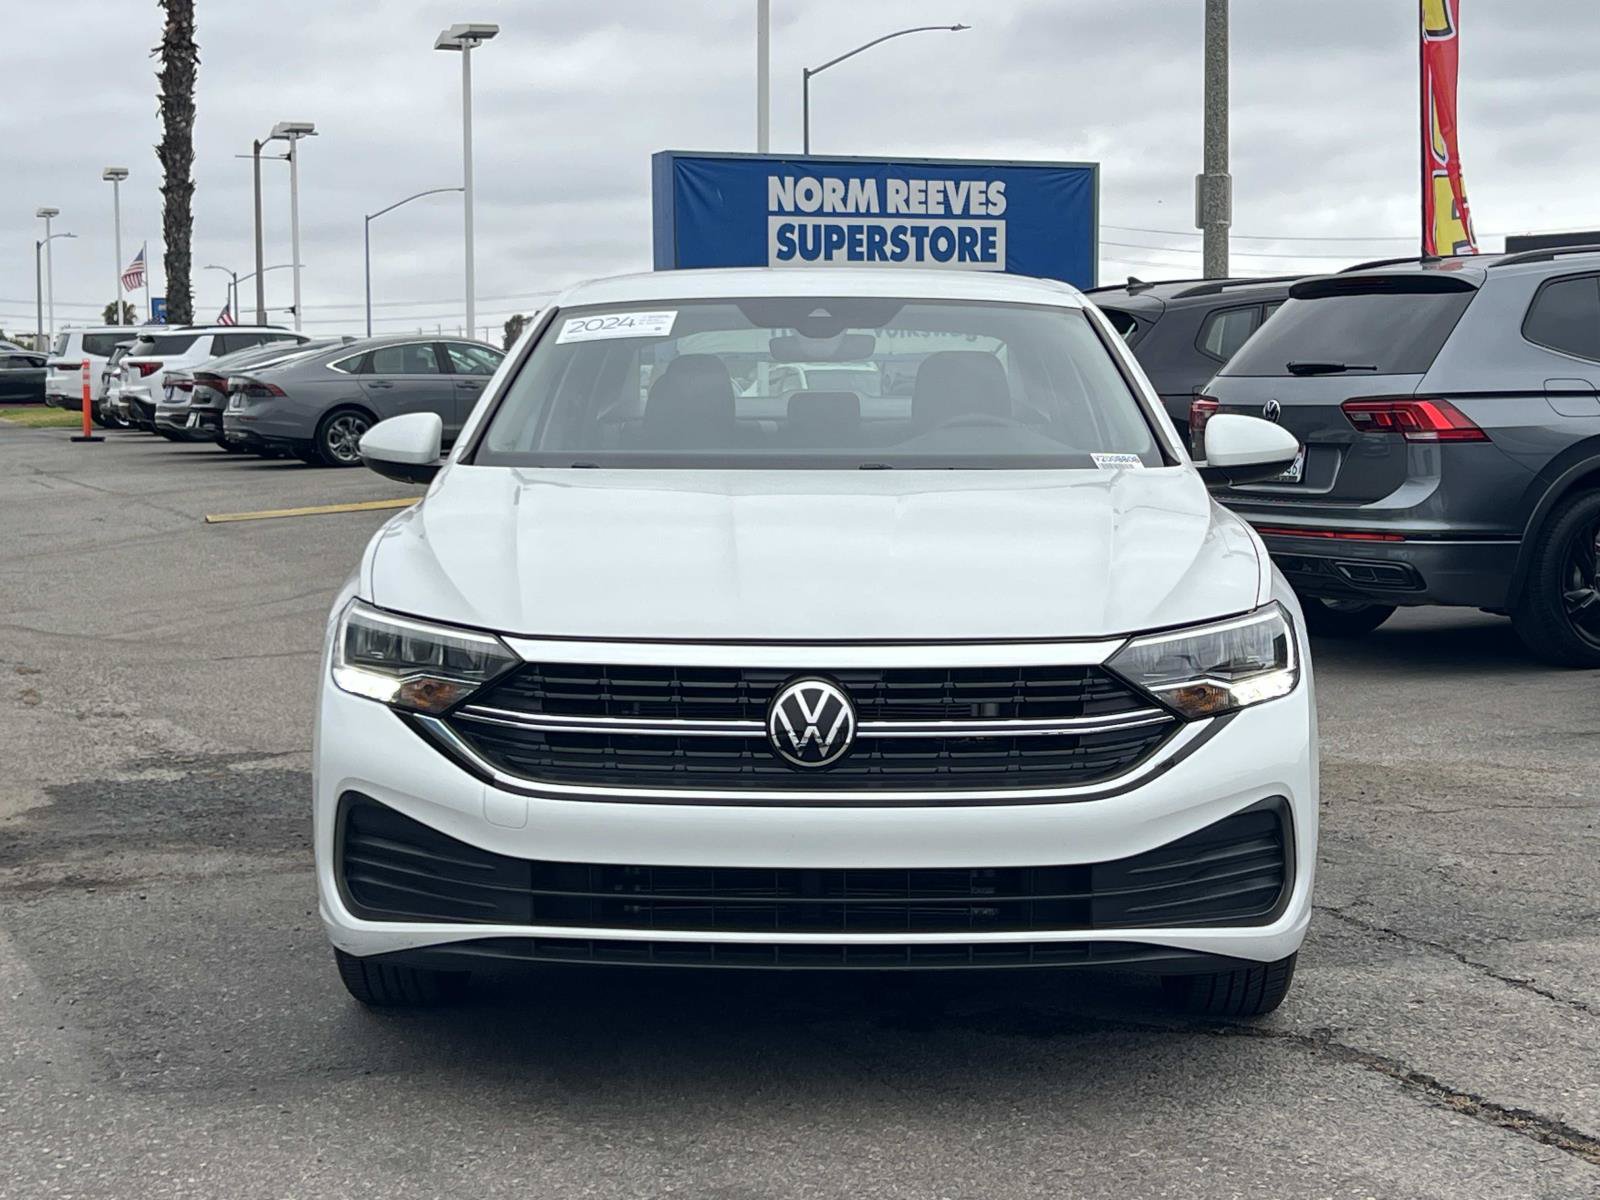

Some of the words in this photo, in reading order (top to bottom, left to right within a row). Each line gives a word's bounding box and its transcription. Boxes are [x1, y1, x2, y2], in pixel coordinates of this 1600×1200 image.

[768, 176, 880, 214] NORM
[887, 179, 1007, 216] REEVES
[777, 224, 998, 263] SUPERSTORE
[569, 317, 636, 334] 2024
[769, 679, 856, 768] VW
